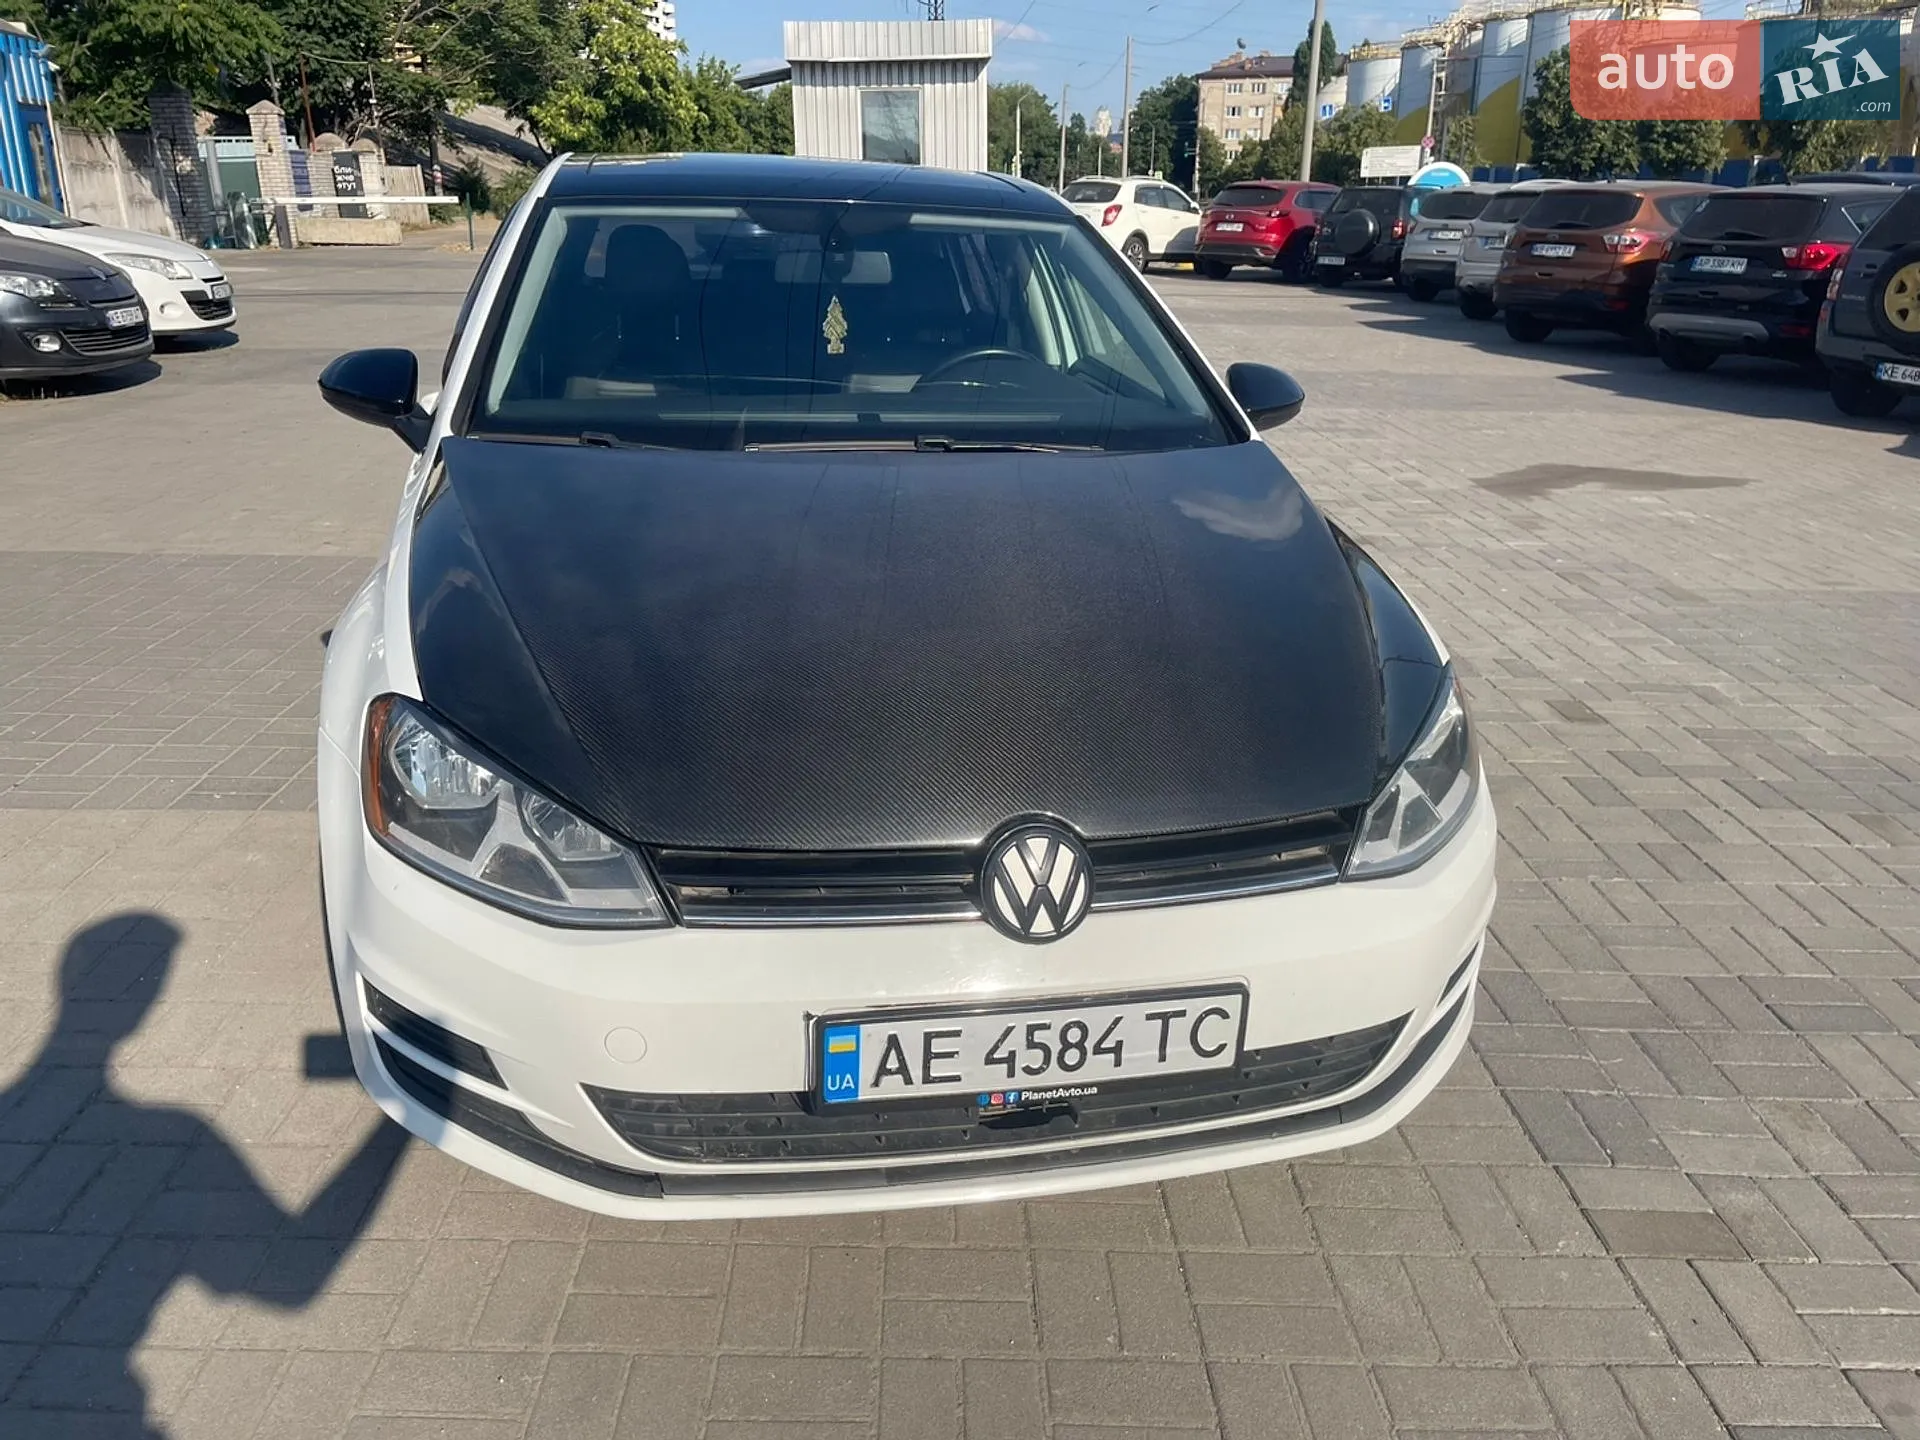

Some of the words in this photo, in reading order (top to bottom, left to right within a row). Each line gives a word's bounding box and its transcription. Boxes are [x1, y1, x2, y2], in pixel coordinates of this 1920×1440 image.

[1883, 365, 1900, 379] KE
[870, 1029, 963, 1088] AE
[983, 1014, 1125, 1080] 4584
[1144, 1006, 1232, 1064] TC
[827, 1073, 855, 1092] UA
[1020, 1084, 1098, 1102] PlanetAvto.ua
